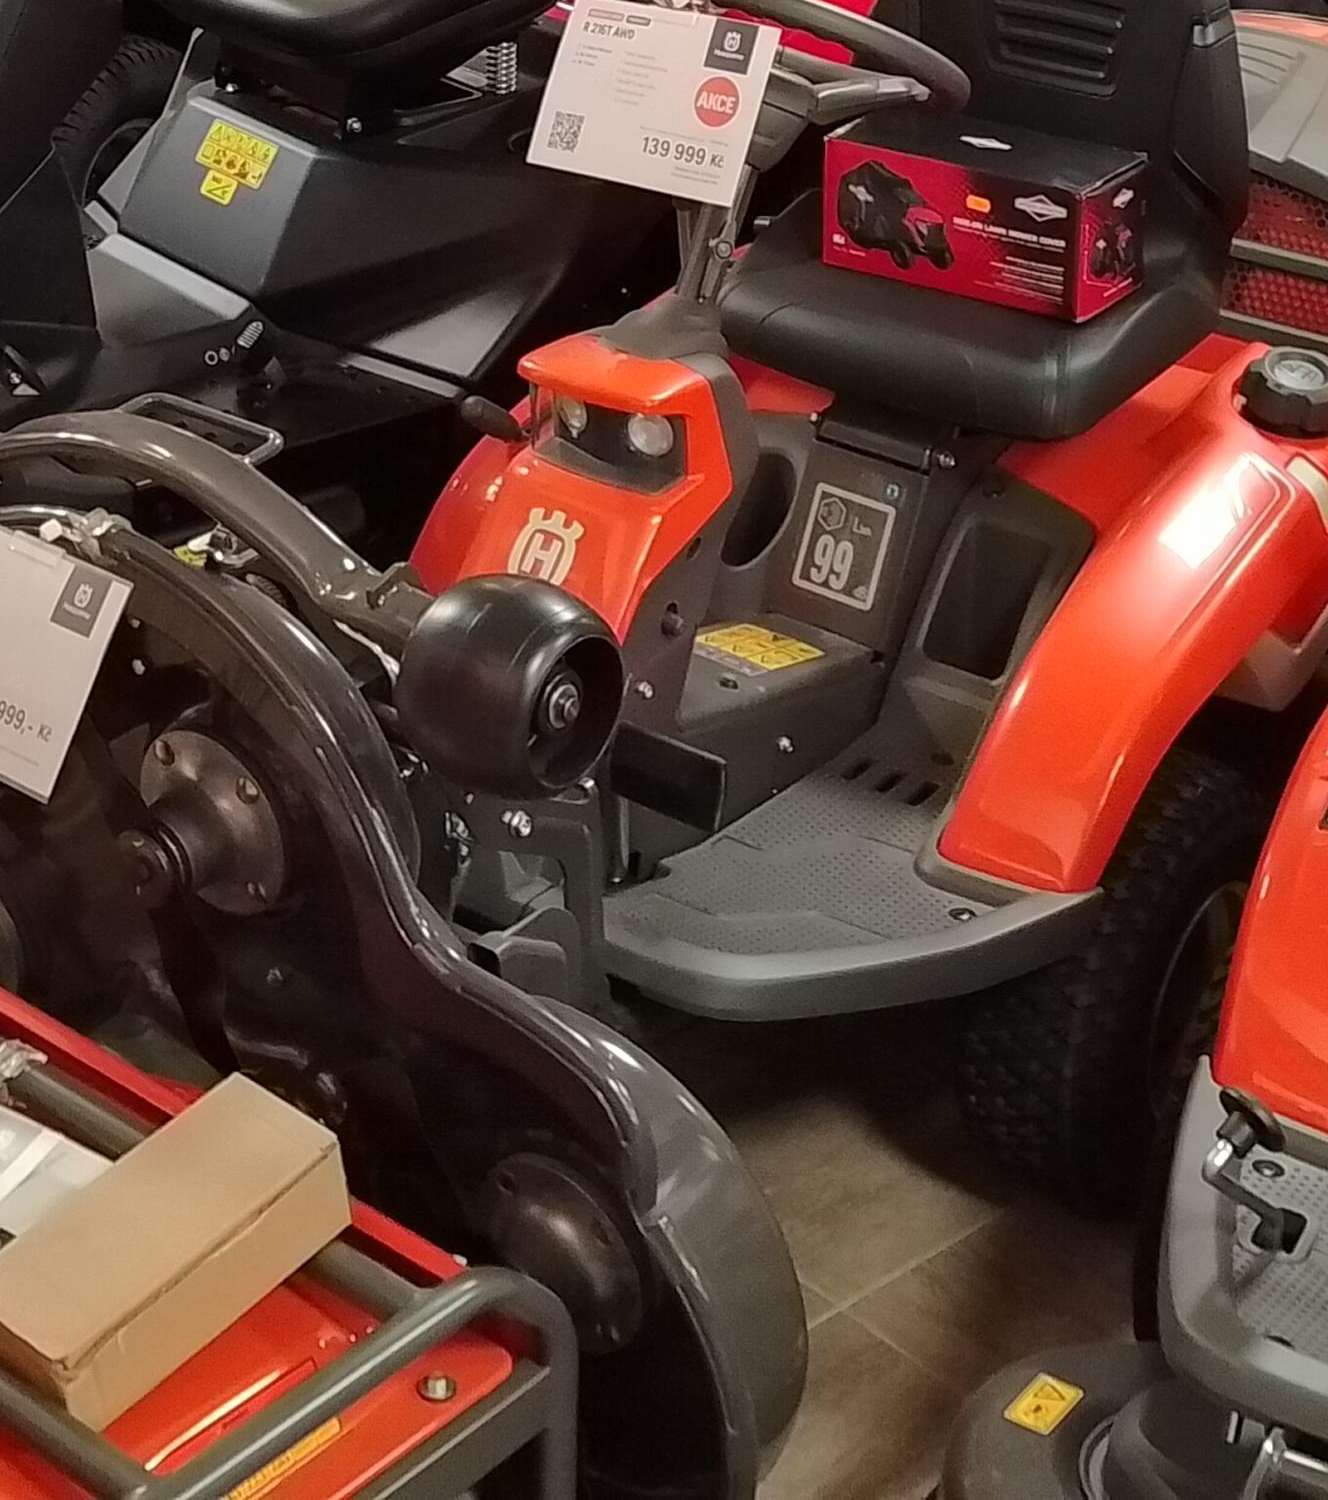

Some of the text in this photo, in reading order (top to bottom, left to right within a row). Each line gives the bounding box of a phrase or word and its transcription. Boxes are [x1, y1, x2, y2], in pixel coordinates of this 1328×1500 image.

[613, 27, 636, 40] AWD
[696, 90, 737, 115] AKCE
[642, 136, 670, 157] 139
[674, 143, 706, 166] 999
[810, 534, 854, 590] 99
